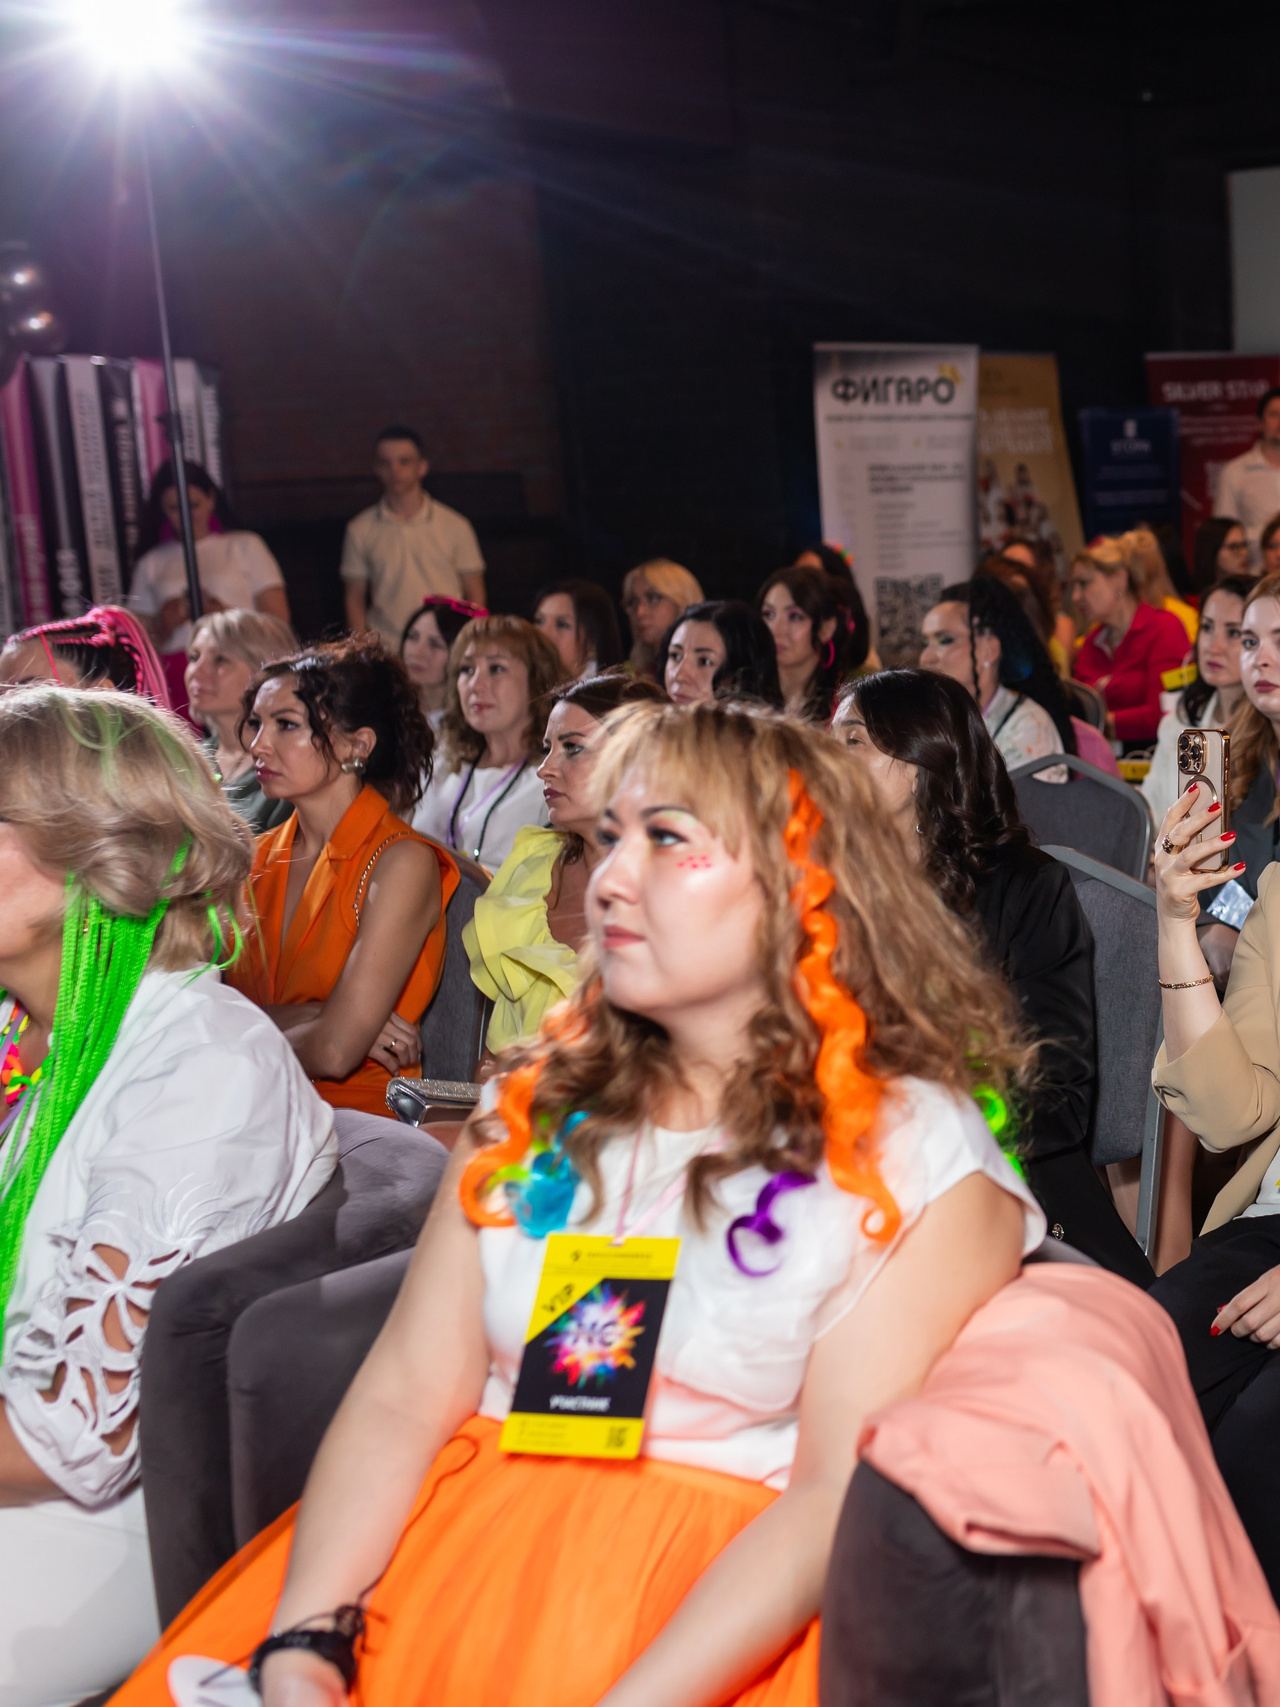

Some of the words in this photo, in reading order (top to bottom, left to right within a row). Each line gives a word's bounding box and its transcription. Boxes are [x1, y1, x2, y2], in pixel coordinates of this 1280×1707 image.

[832, 375, 955, 405] ФИГАРО
[1162, 380, 1223, 402] SILVER
[543, 1283, 574, 1311] VIP
